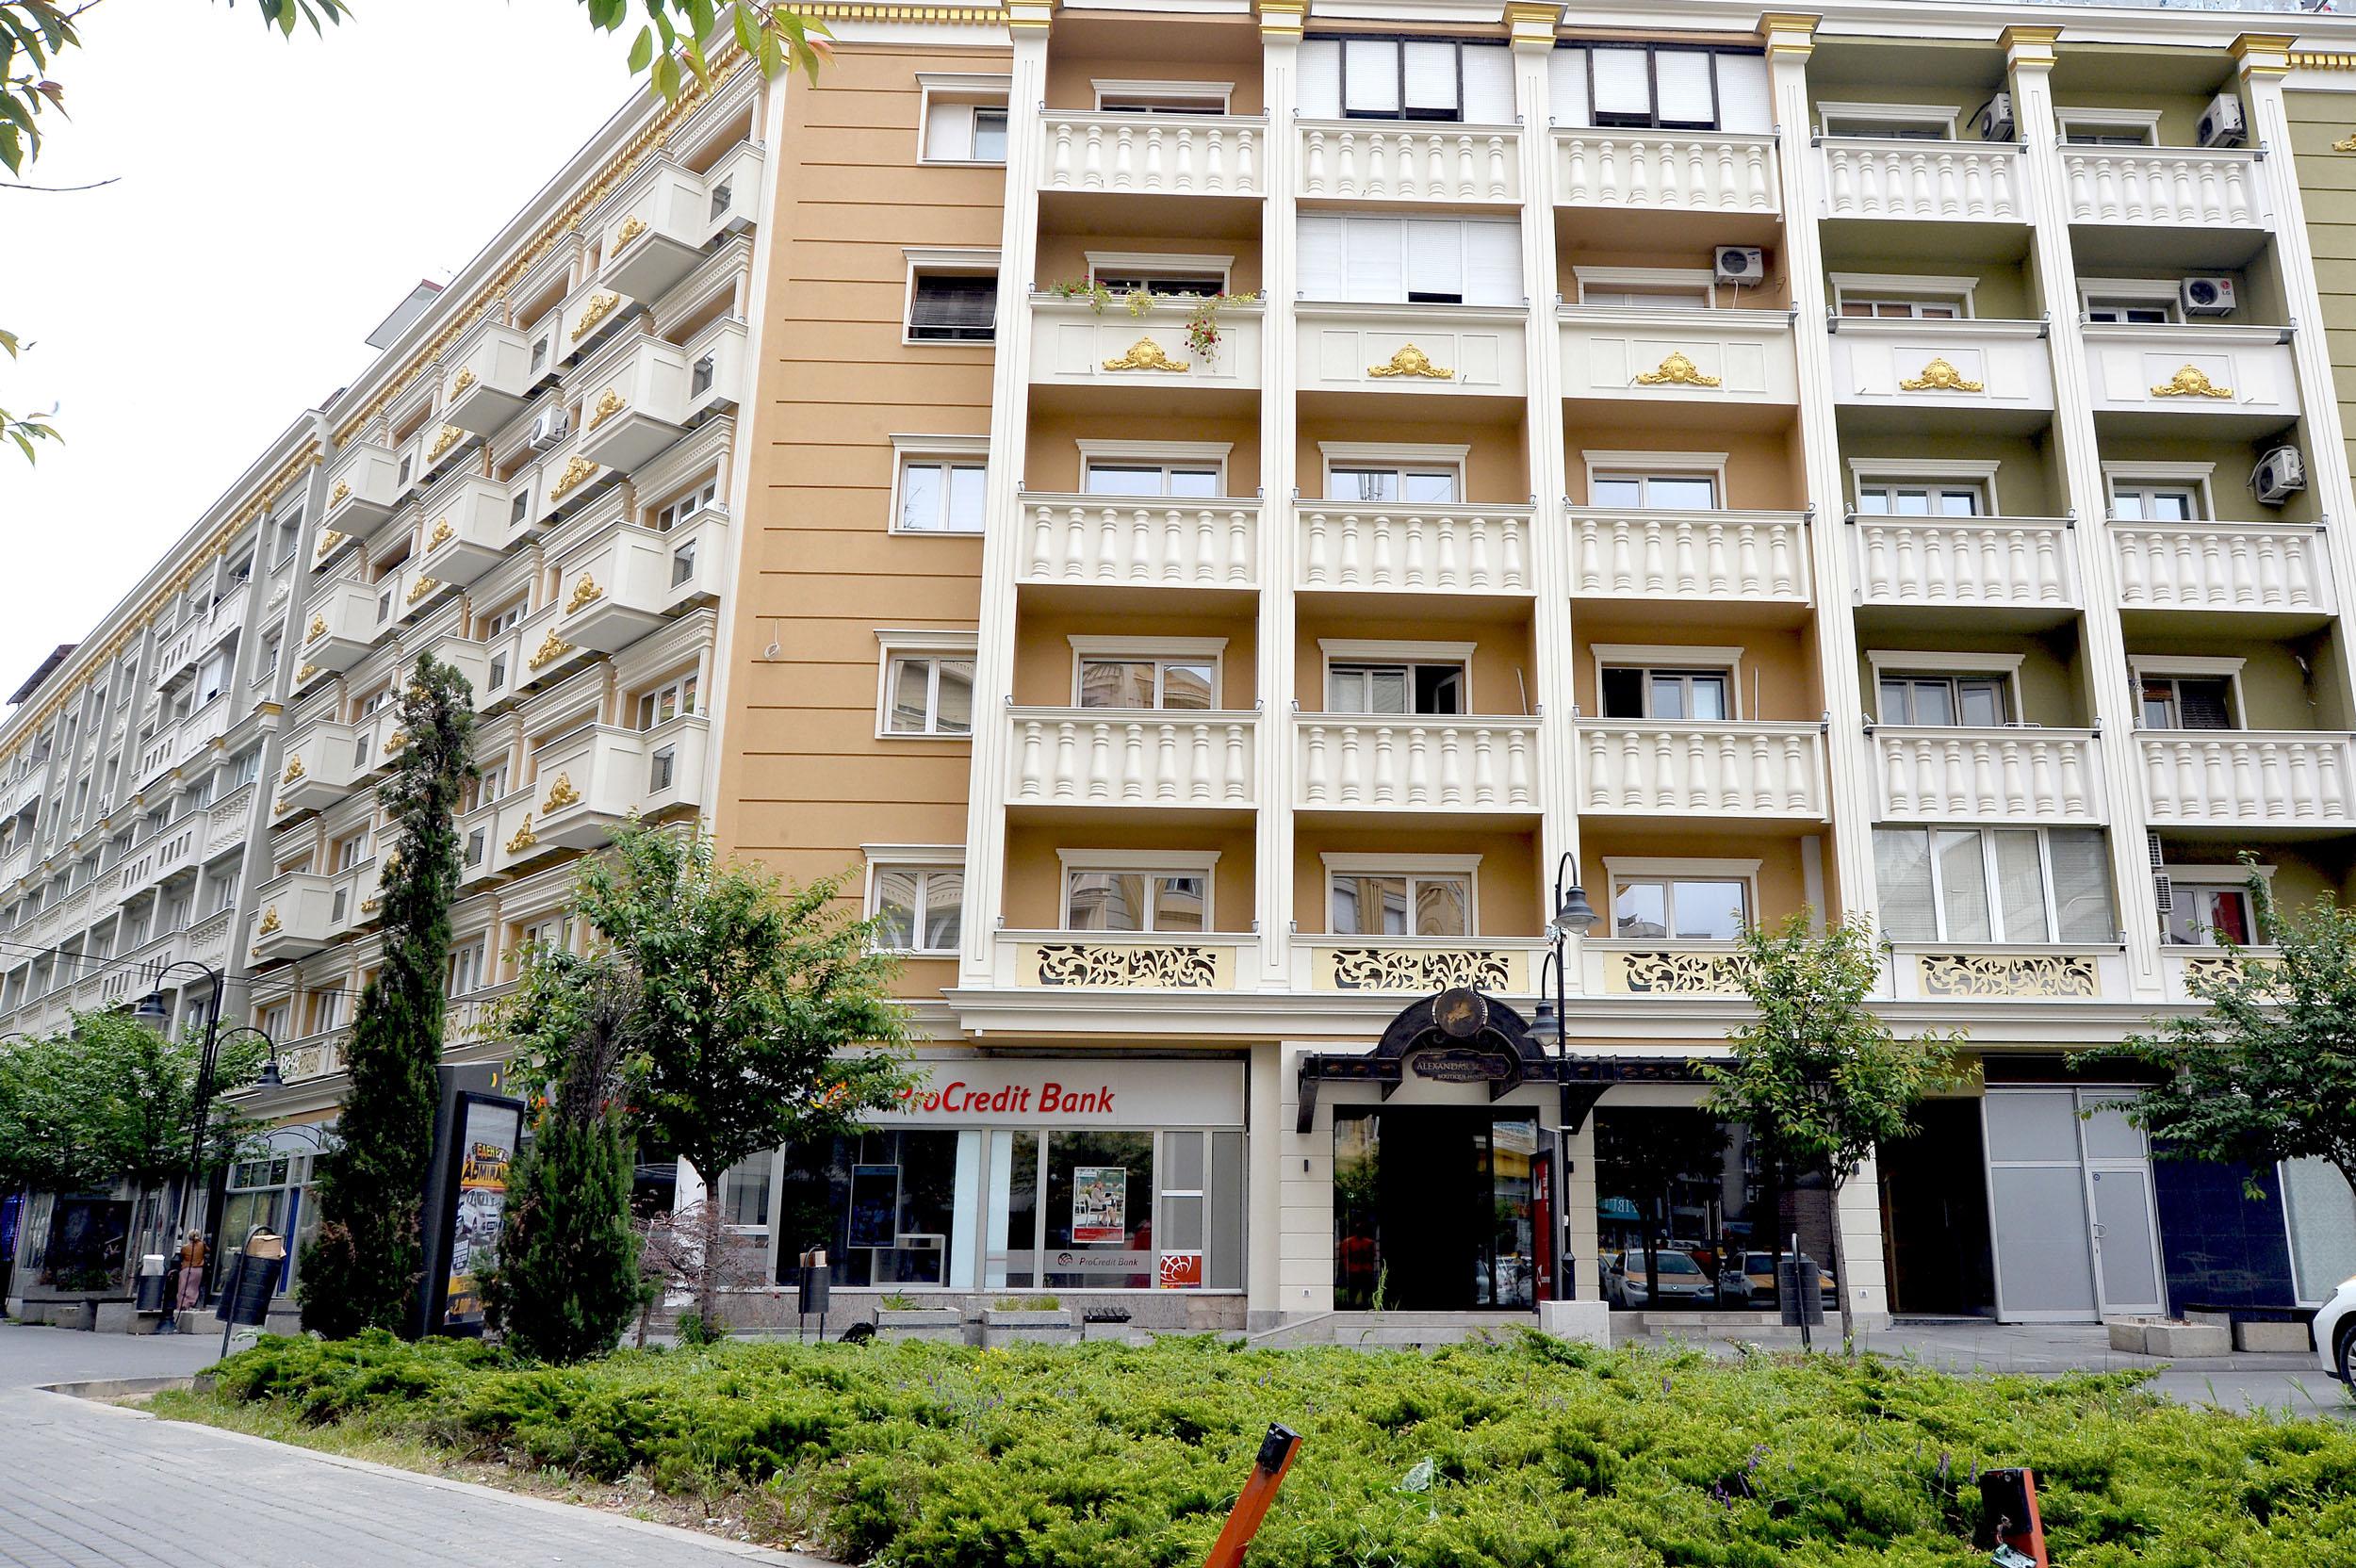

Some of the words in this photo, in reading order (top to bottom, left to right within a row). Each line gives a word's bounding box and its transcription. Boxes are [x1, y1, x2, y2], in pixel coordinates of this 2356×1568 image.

[1038, 1083, 1115, 1113] Bank
[1079, 1257, 1116, 1266] ProCredit
[1118, 1258, 1138, 1266] Bank
